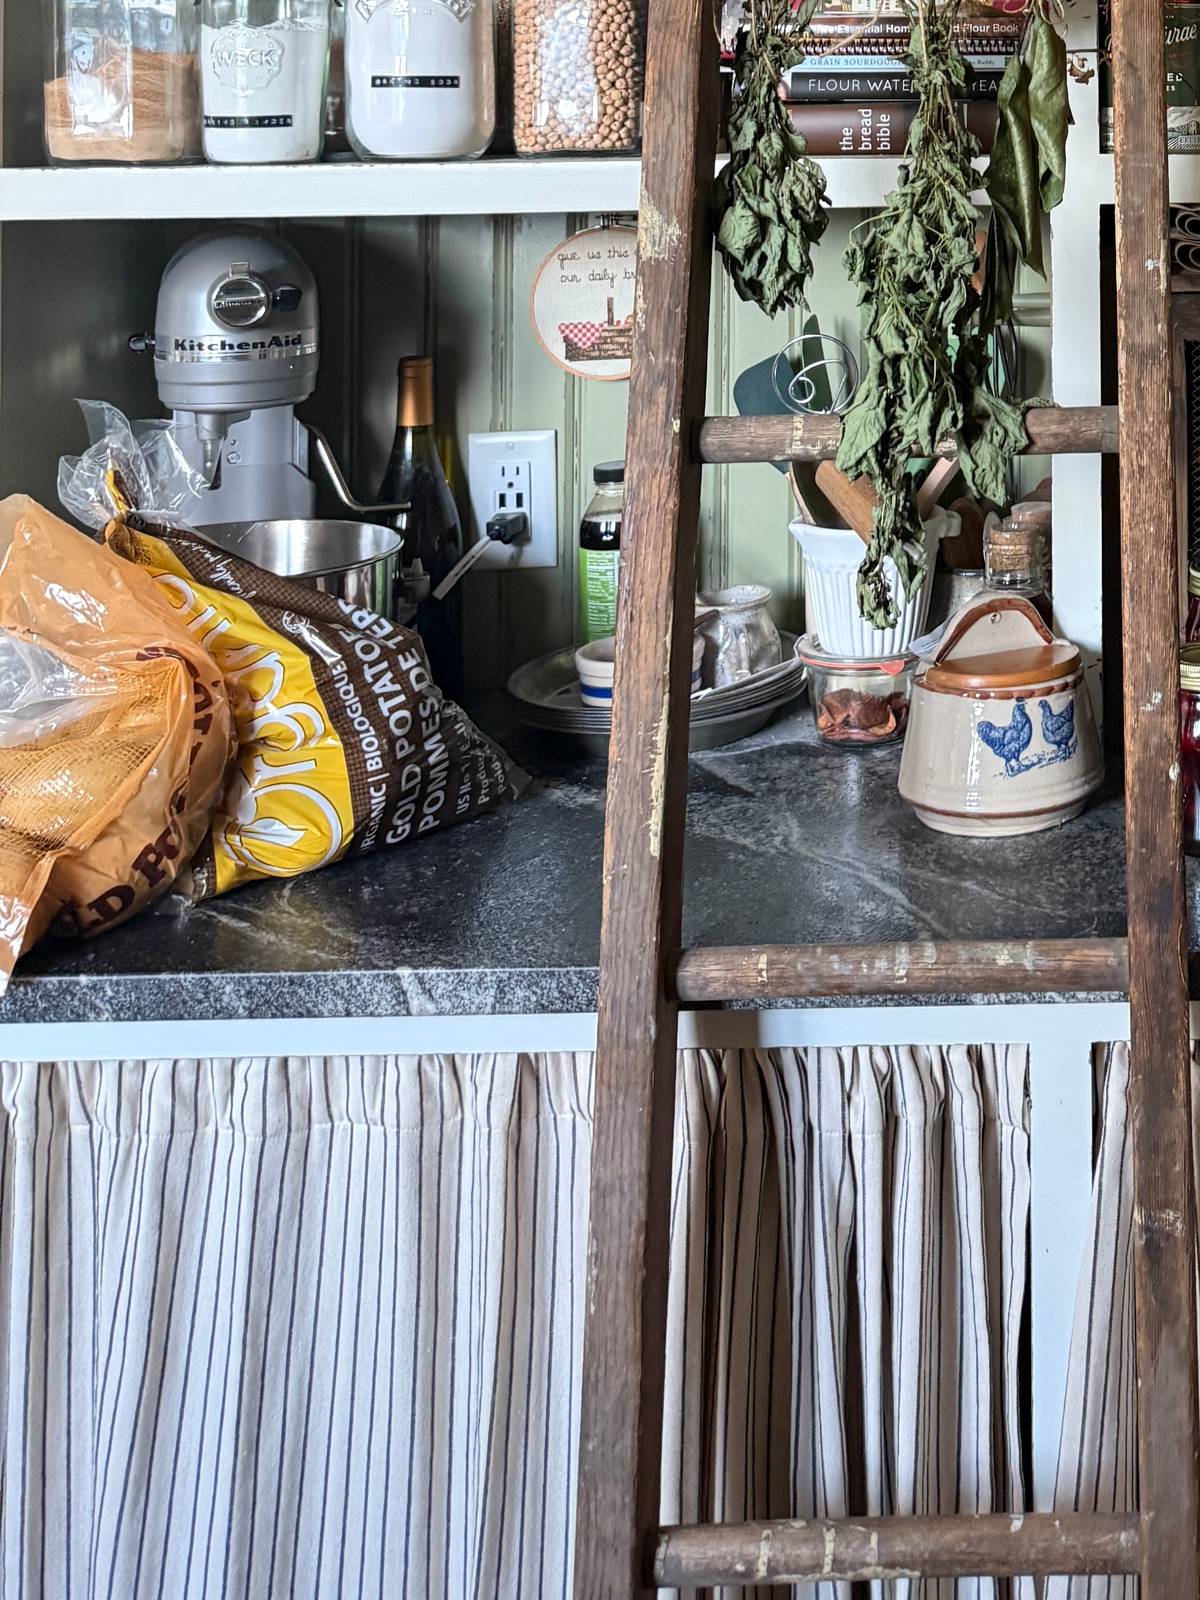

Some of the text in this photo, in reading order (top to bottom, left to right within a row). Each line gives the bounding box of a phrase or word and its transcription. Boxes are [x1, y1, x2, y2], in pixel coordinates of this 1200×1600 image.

[885, 24, 910, 33] Hom
[963, 23, 1019, 33] Flour Book
[217, 50, 275, 67] WECK
[808, 79, 861, 91] FLOUR
[839, 127, 853, 150] the
[858, 108, 872, 150] bread
[877, 113, 891, 150] bible
[558, 246, 629, 270] give us this
[561, 274, 581, 283] our
[588, 268, 618, 288] daily
[174, 334, 302, 351] KitchenAid
[331, 660, 381, 773] BIOLOGIQUE
[397, 647, 449, 833] POMMES DE
[385, 763, 422, 845] GOLD
